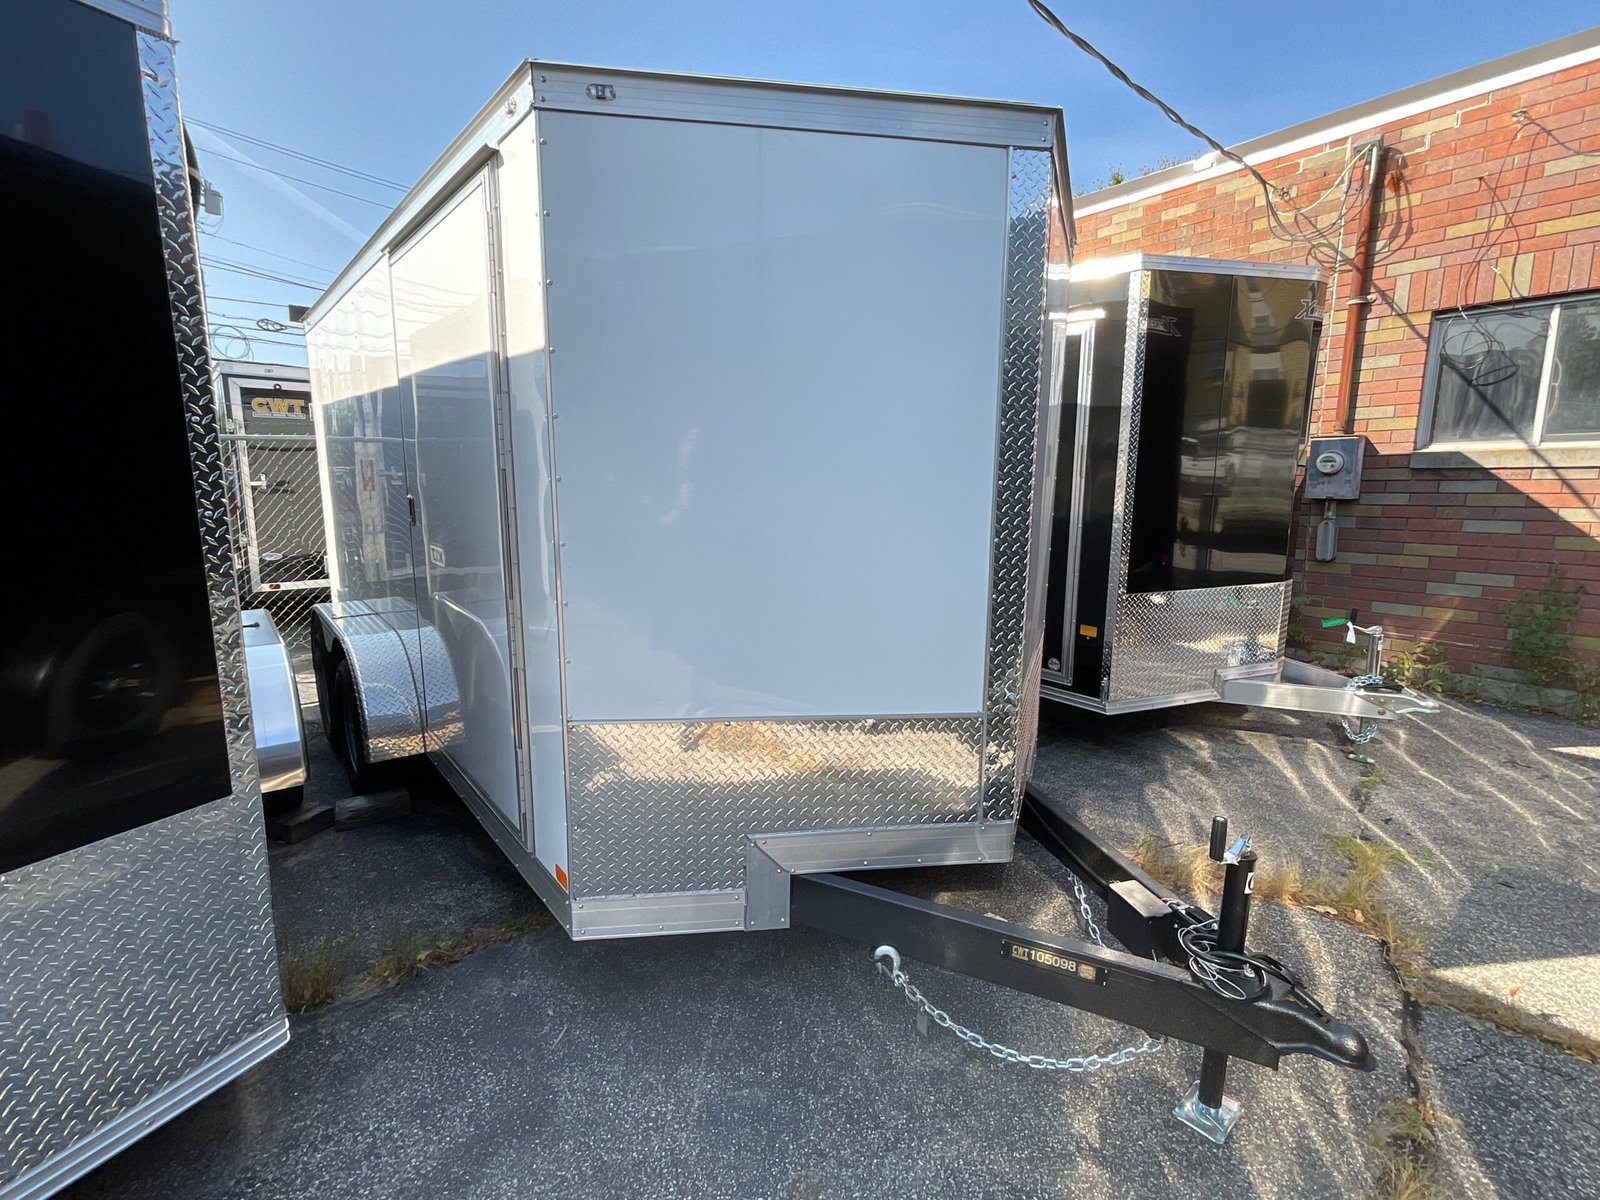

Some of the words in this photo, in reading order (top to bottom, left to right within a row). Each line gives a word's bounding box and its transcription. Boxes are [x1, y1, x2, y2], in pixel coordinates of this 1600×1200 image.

[251, 397, 304, 413] CWT
[1012, 945, 1029, 957] CWT
[1030, 950, 1076, 972] 105098
